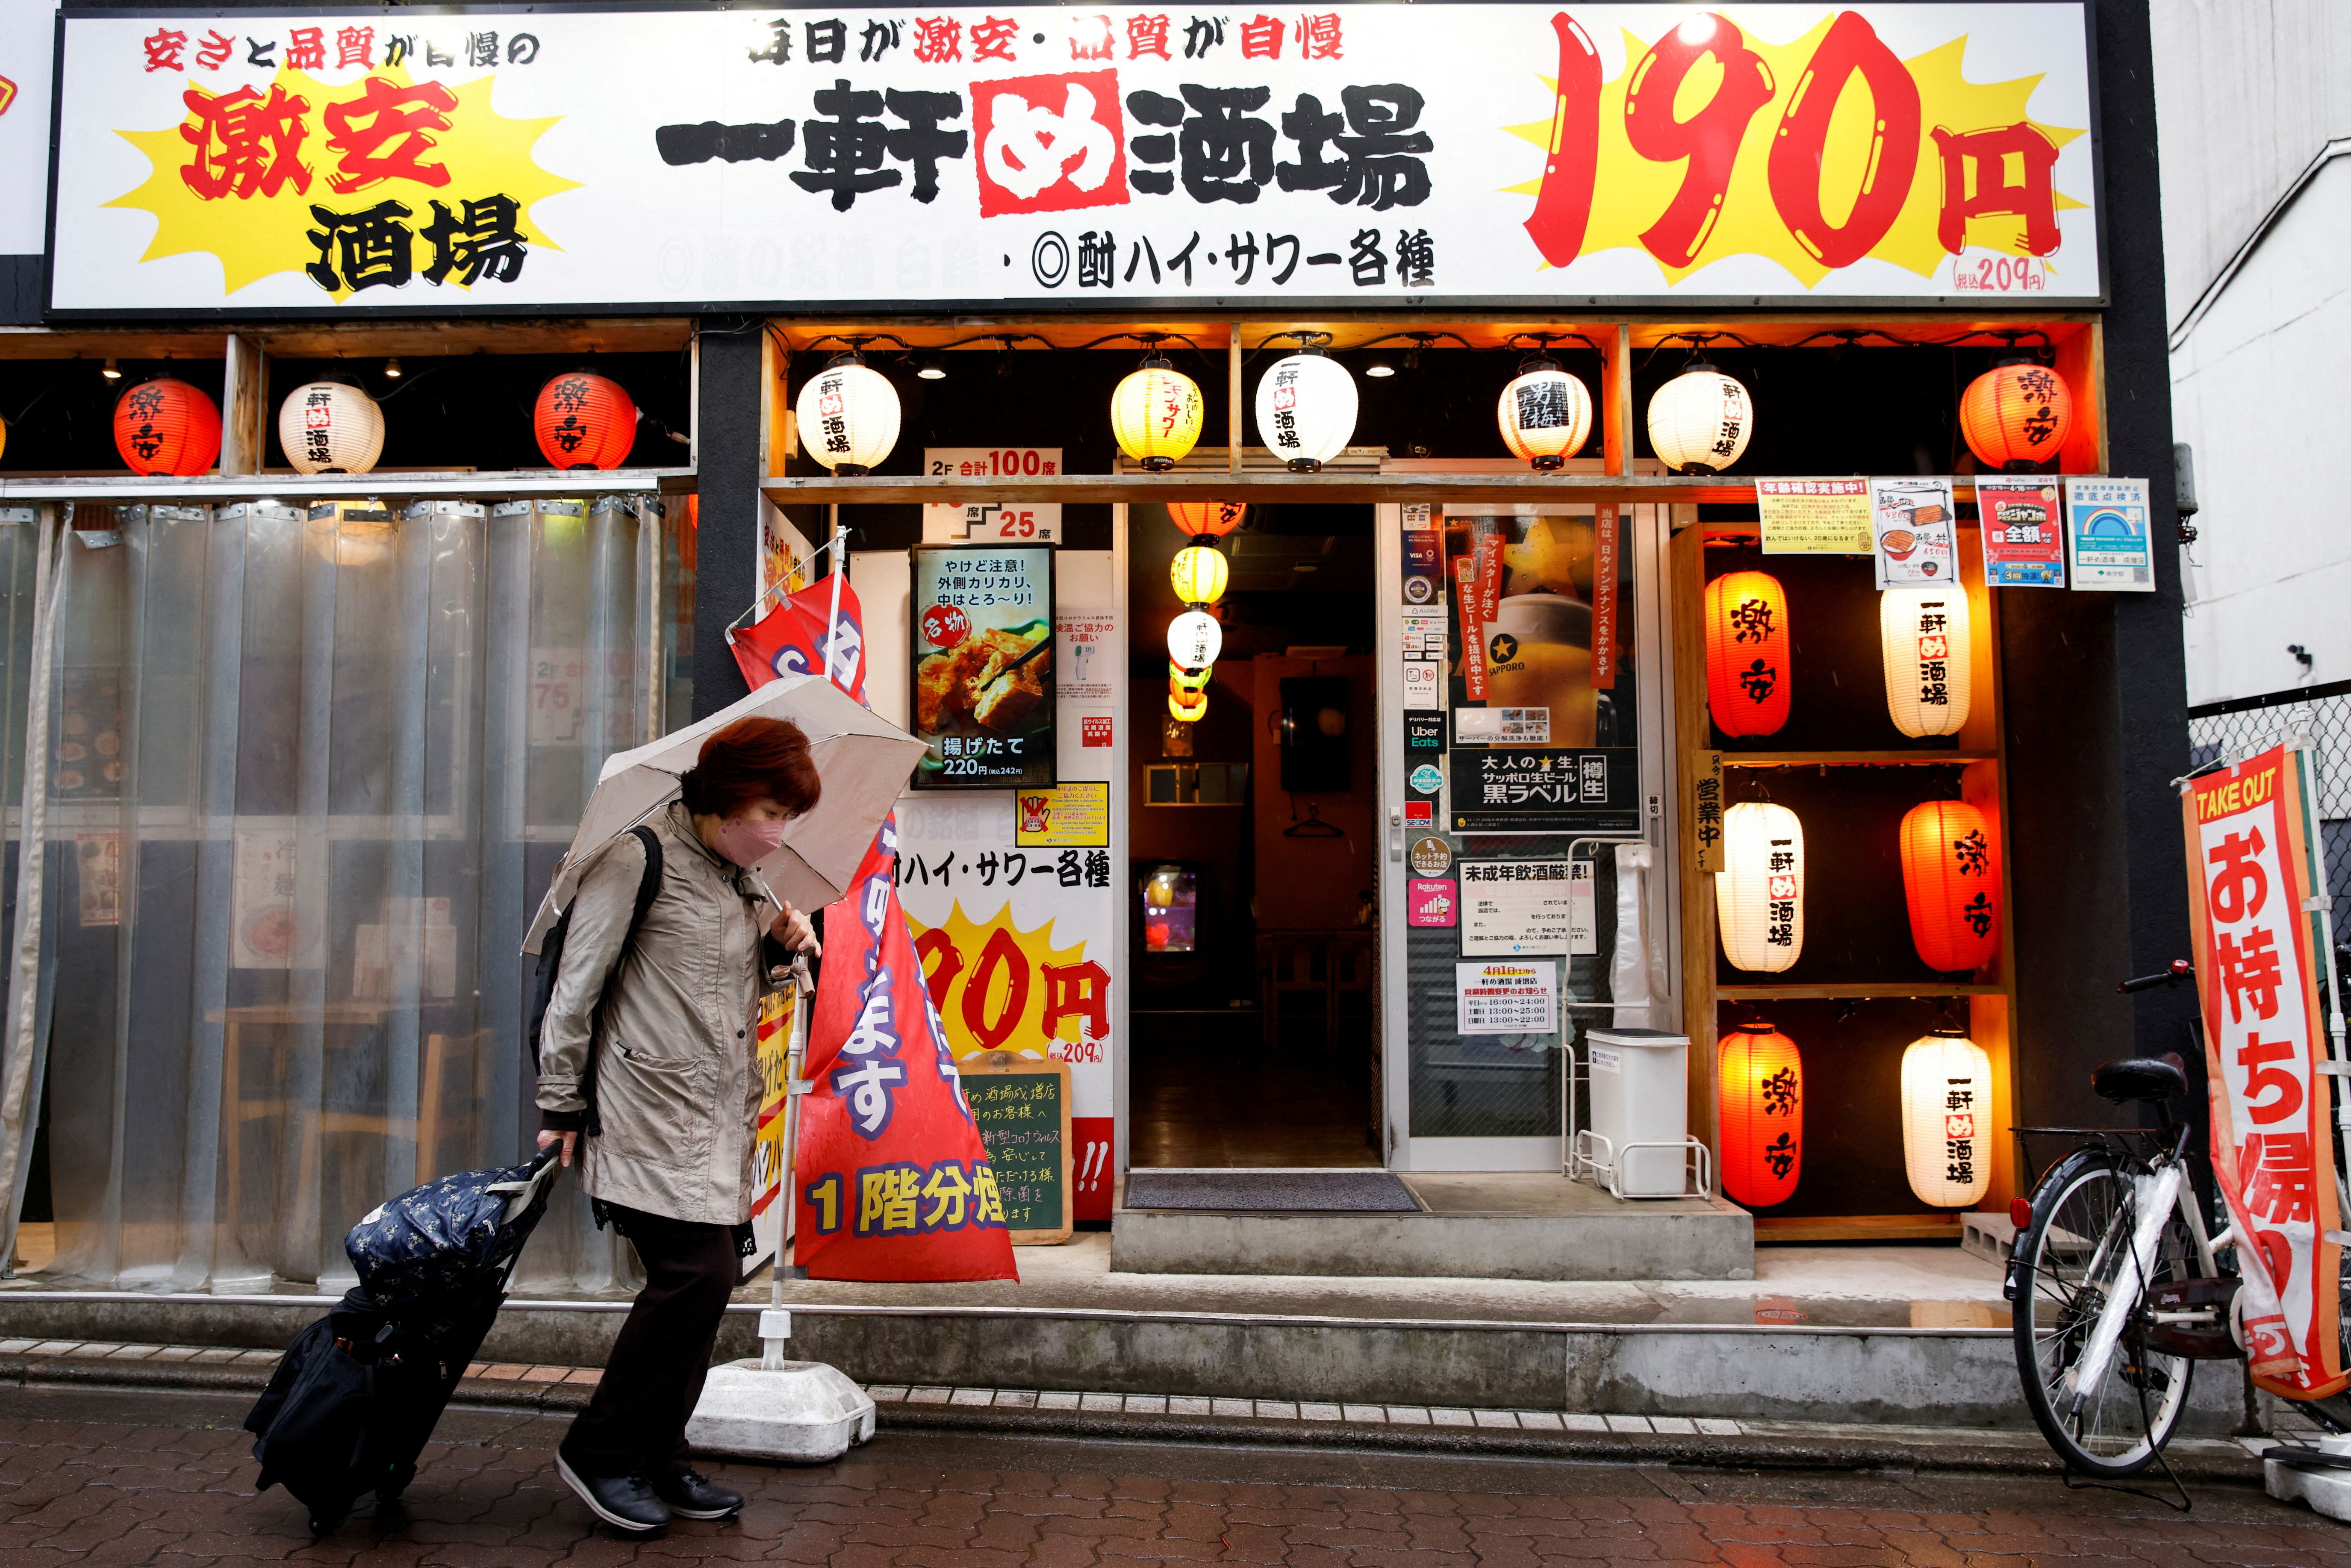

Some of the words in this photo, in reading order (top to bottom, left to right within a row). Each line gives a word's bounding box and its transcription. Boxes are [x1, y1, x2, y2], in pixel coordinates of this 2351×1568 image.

[142, 26, 540, 73] 安さと品質が自慢の
[179, 76, 459, 201] 激安
[655, 68, 1434, 218] 一軒め酒場
[1523, 11, 2061, 268] 190円
[306, 194, 529, 293] 酒場
[1953, 259, 2046, 290] (税込209円)
[129, 385, 165, 462] 激安
[306, 386, 331, 464] 一軒め酒場
[554, 376, 590, 454] 激安
[820, 371, 851, 454] 一軒め酒場
[1273, 362, 1301, 450] 一軒め酒場
[2018, 368, 2059, 447] 激安
[932, 461, 954, 476] 2F
[960, 450, 1056, 476] 合計100席
[2074, 492, 2141, 502] 徹底点検済
[2005, 526, 2041, 543] 全額
[938, 577, 1031, 590] 外側カリカリ、
[945, 559, 1024, 573] やけど注意!
[1482, 540, 1500, 618] マイスターが注ぐ
[1597, 509, 1614, 676] 当店は、日々メンテナンスをかかさず
[924, 611, 966, 640] 名物
[1069, 634, 1099, 642] お願い
[1489, 662, 1525, 677] SAPPORO
[1731, 599, 1776, 704] 激安
[1918, 602, 1947, 706] 一軒め酒場
[943, 737, 1024, 756] 揚げたて
[1411, 727, 1438, 736] Uber
[1411, 737, 1439, 747] Eats
[943, 759, 987, 775] 220円
[1482, 772, 1576, 783] サッポロ生ビール
[1583, 762, 1604, 797] 樽生
[1483, 784, 1576, 803] 黒ラベル
[1697, 778, 1721, 848] 営業中
[2197, 787, 2241, 821] TAKE
[2242, 767, 2276, 807] OUT
[1414, 852, 1447, 860] ネット予約
[1465, 864, 1587, 881] 未成年飲酒厳禁!
[1417, 883, 1447, 892] Rakuten
[1768, 838, 1796, 947] 一軒め酒場
[1954, 829, 1993, 938] 激安
[1483, 966, 1536, 975] 4月1日(土)から
[1046, 1042, 1104, 1063] (税込209円)
[1762, 1066, 1799, 1180] 激安
[1945, 1077, 1975, 1184] 一軒め酒場
